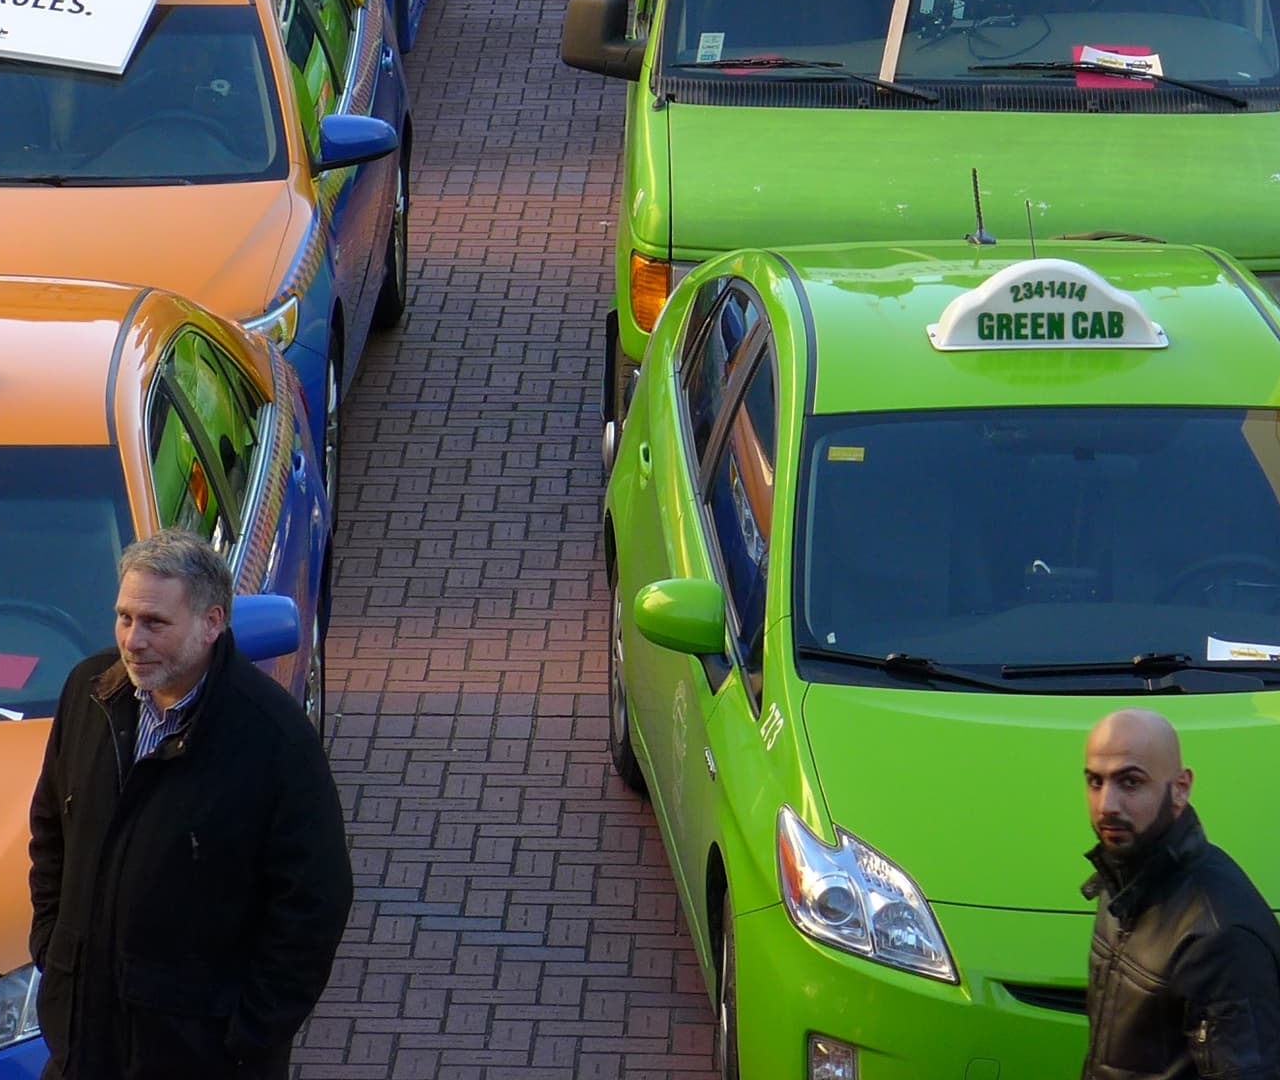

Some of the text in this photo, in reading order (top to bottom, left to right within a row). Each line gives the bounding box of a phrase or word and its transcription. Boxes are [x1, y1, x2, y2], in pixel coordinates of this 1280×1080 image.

[1010, 280, 1087, 303] 234-1414
[978, 311, 1124, 341] GREEN CAB
[760, 702, 784, 752] 273
